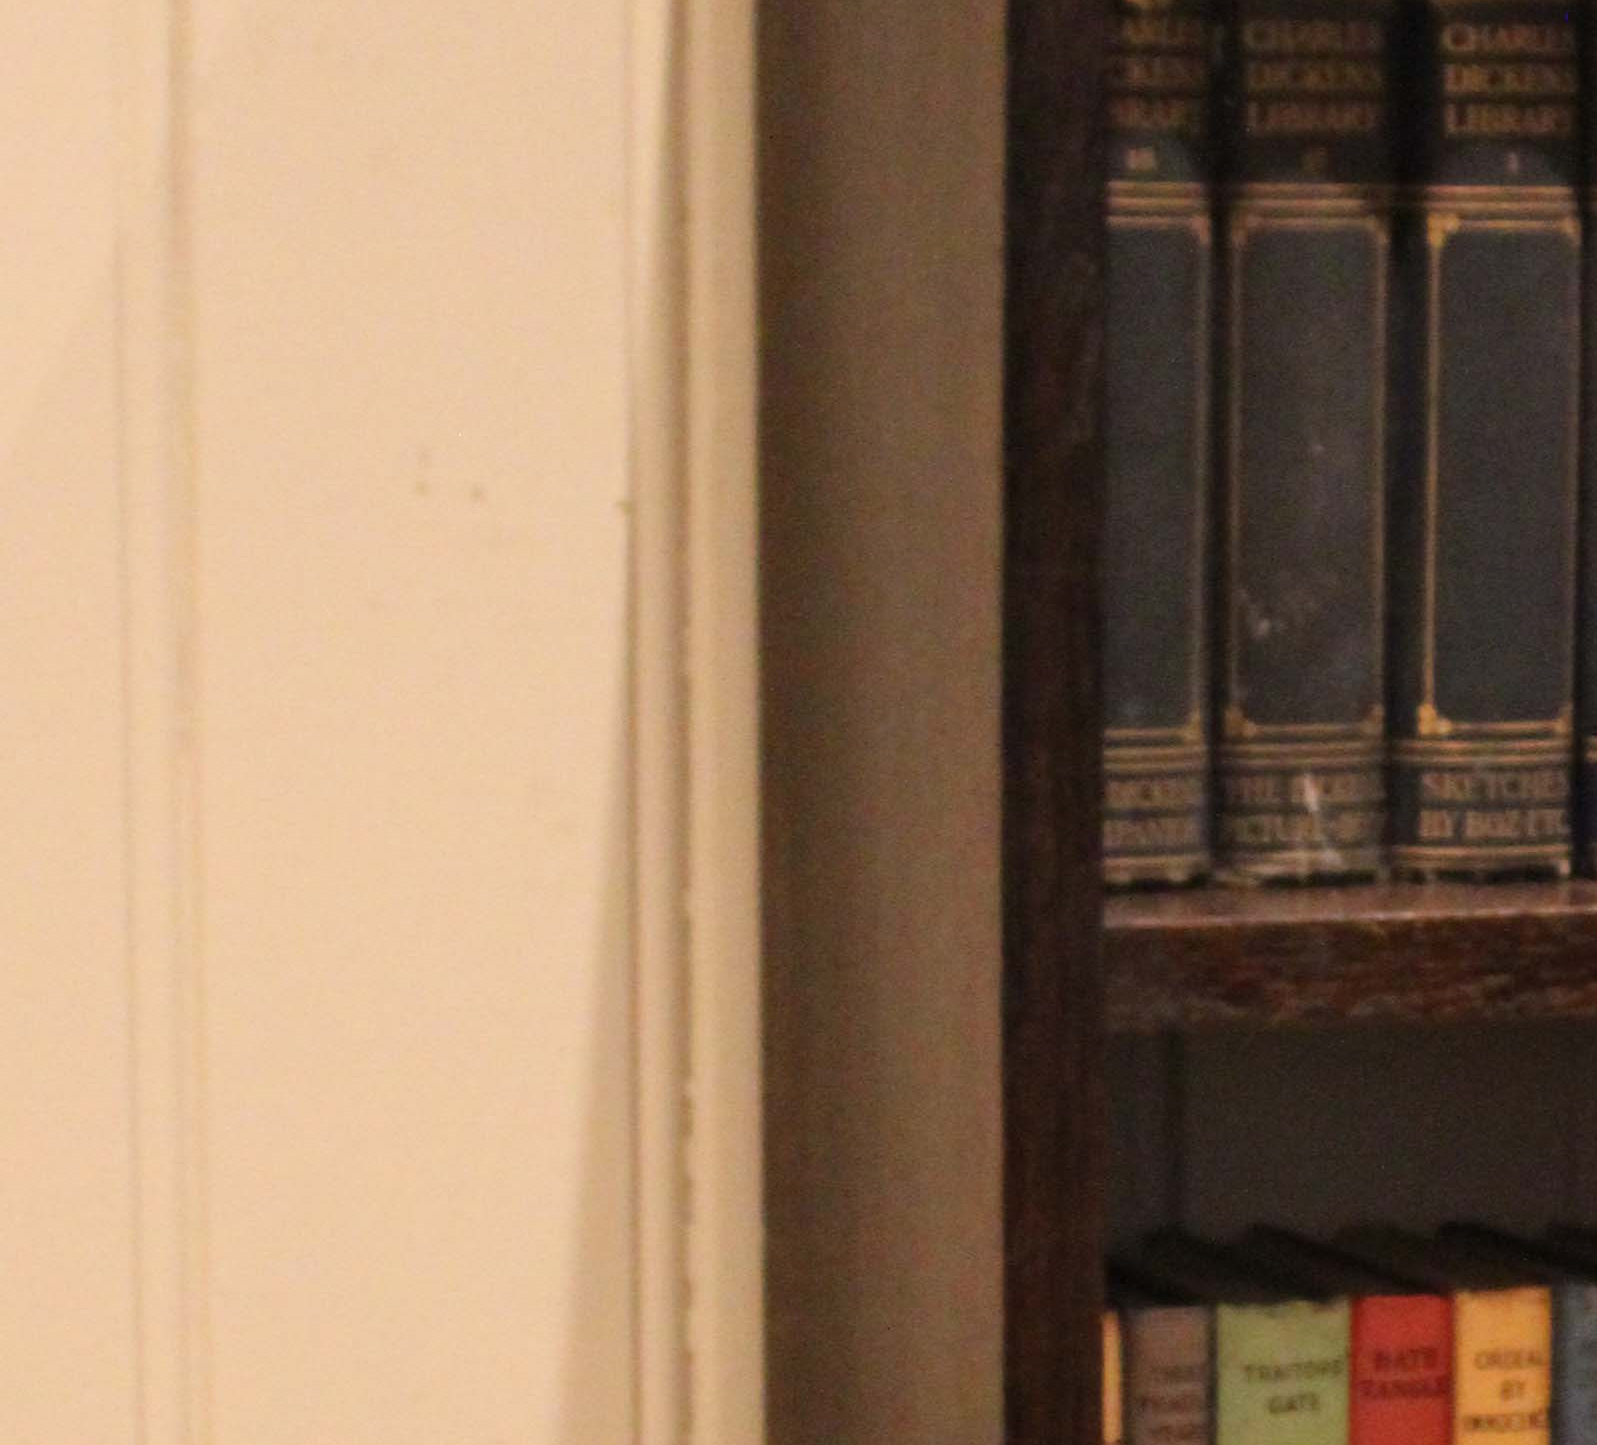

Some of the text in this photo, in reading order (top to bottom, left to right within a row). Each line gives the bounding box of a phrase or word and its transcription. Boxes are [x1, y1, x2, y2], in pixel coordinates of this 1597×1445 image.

[1243, 20, 1384, 50] CHARLES
[1442, 24, 1577, 53] CHARLES
[1246, 62, 1383, 91] DICKENS
[1444, 63, 1577, 93] DICKENS
[1246, 101, 1381, 136] LIBRARY
[1444, 103, 1572, 135] LIBRARY
